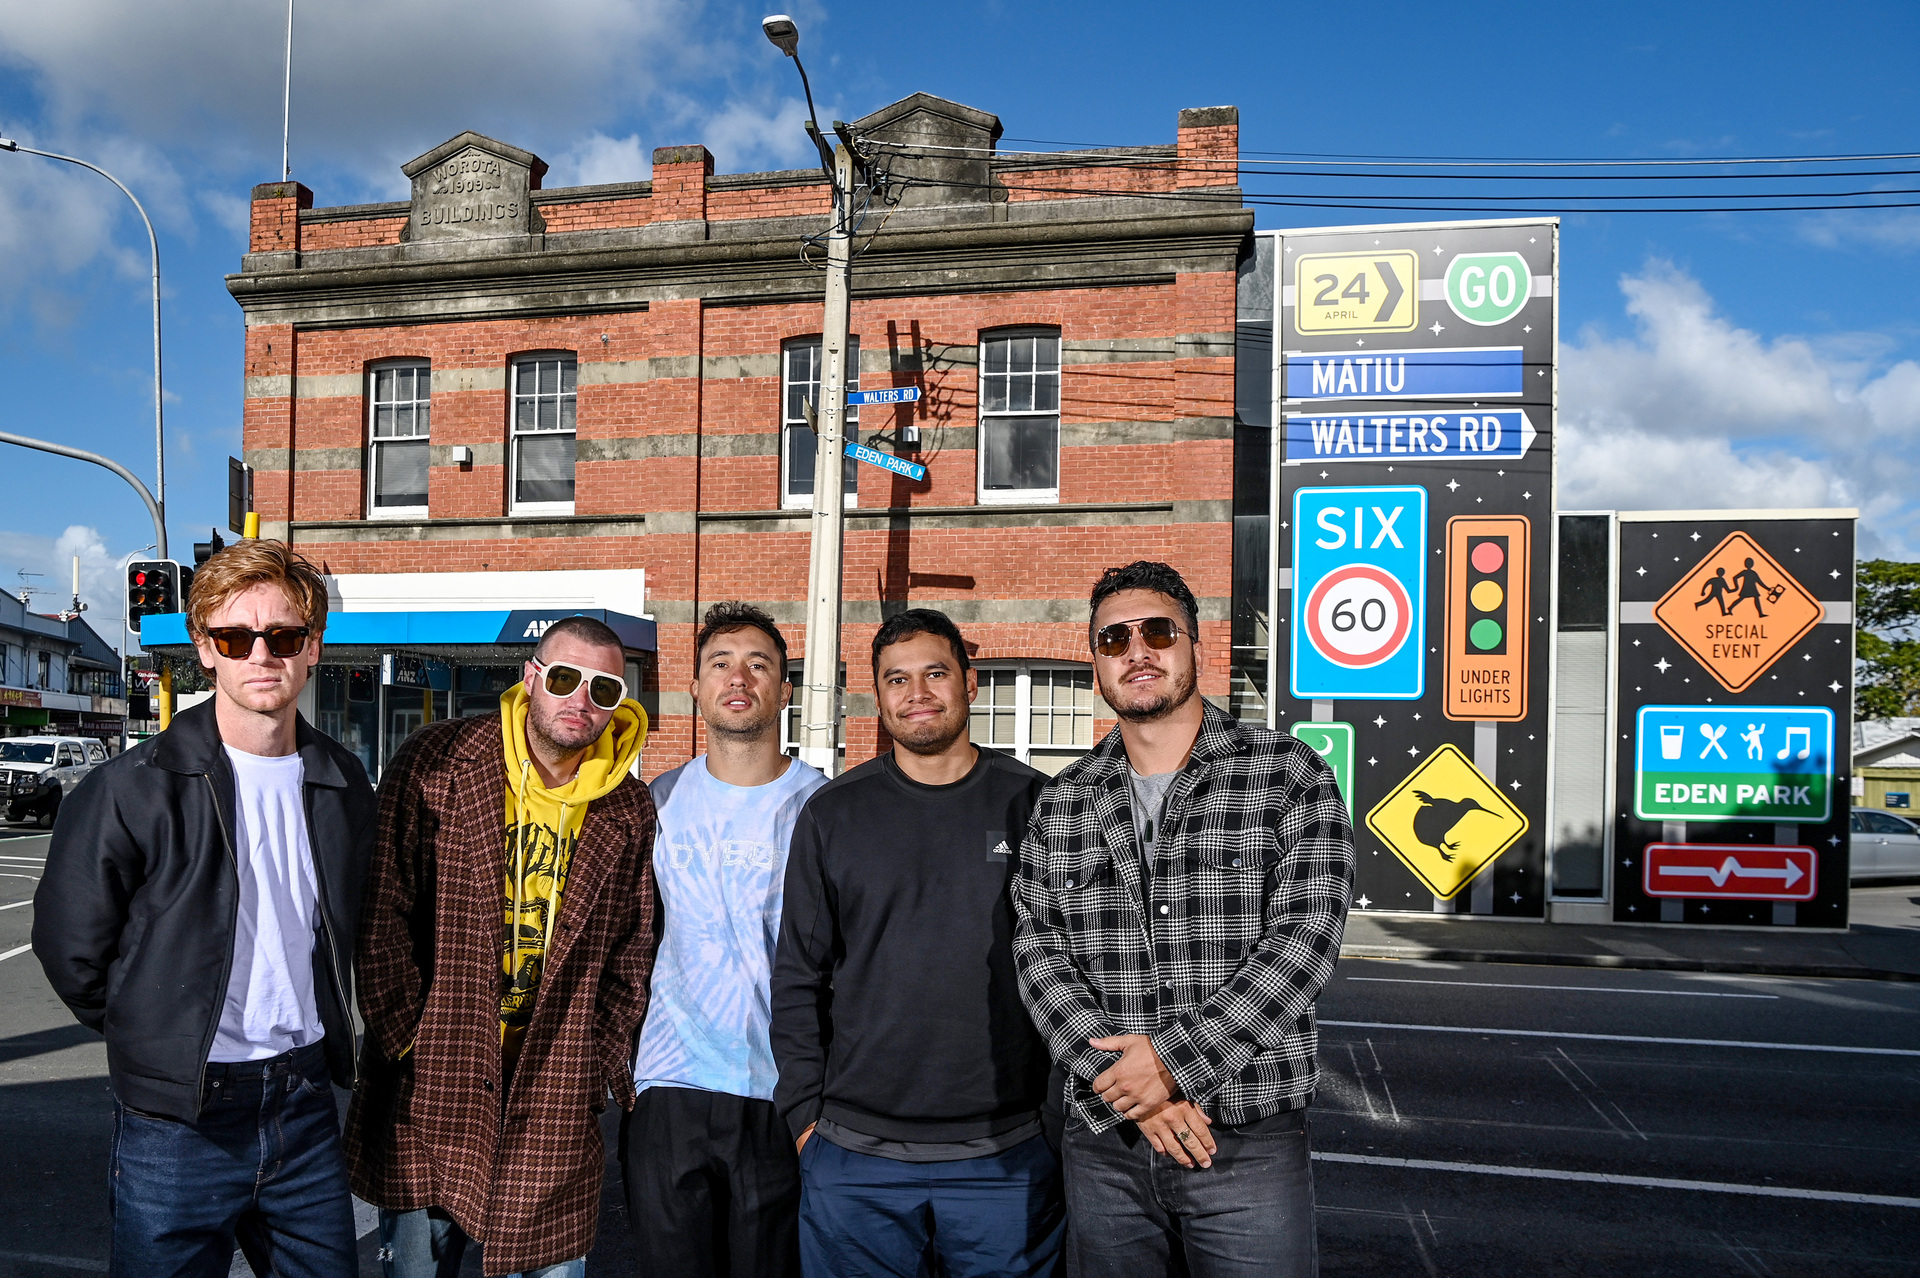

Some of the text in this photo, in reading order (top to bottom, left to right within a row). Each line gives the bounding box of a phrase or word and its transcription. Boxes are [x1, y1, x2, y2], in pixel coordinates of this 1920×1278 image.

[433, 160, 501, 183] WOROTA
[449, 180, 484, 194] 1909
[421, 203, 519, 225] BUILDINGS
[1313, 272, 1370, 306] 24
[1459, 265, 1516, 308] GO
[1324, 310, 1358, 320] APRIL
[1312, 357, 1405, 394] MATIU
[863, 389, 914, 403] WALTERS RD
[1310, 416, 1502, 455] WALTERS RD
[855, 446, 913, 476] EDEN PARK
[1315, 506, 1405, 550] SIX
[1331, 598, 1386, 632] 60
[523, 620, 559, 638] AN
[1705, 624, 1768, 639] SPECIAL
[1713, 644, 1761, 658] EVENT
[396, 669, 416, 684] ANZ
[1461, 669, 1511, 684] UNDER
[1460, 689, 1511, 704] LIGHTS
[1655, 783, 1812, 806] EDEN PARK
